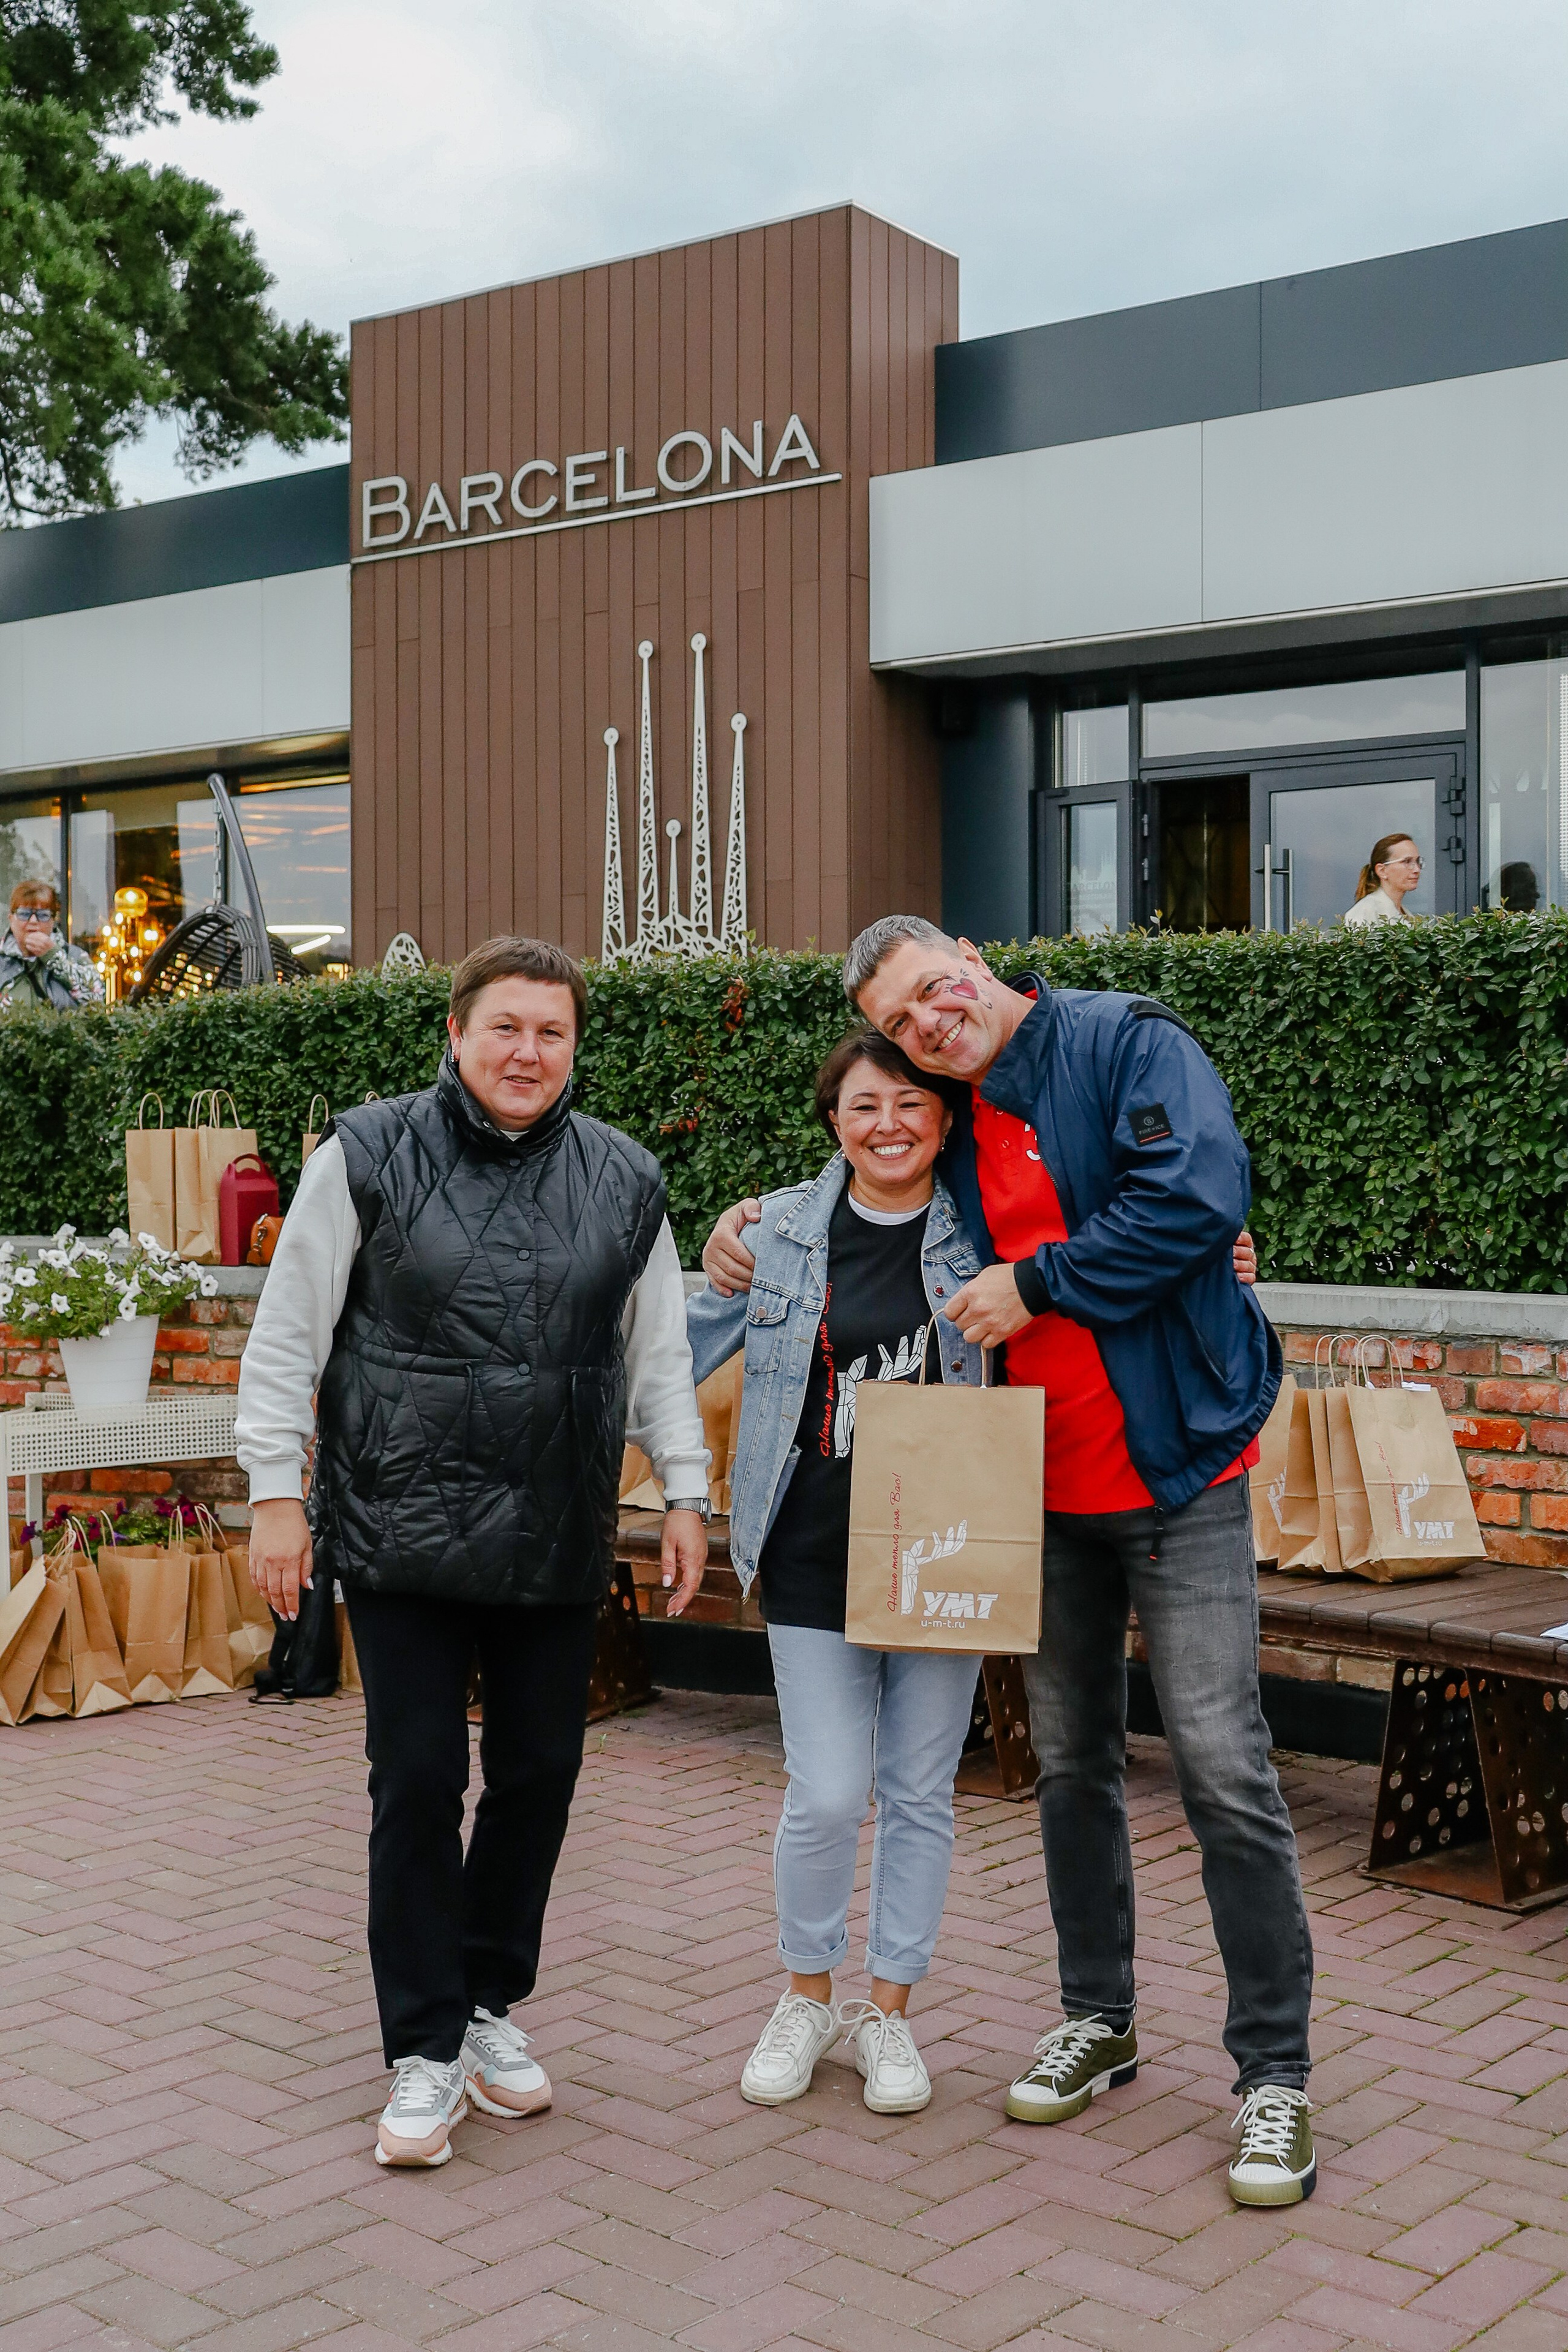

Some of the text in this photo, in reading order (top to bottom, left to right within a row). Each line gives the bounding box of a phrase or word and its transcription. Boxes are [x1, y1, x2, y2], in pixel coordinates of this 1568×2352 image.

[363, 413, 821, 548] BARCELONA
[820, 1322, 834, 1351] для
[818, 1404, 831, 1457] Наше
[889, 1472, 901, 1506] Вас!
[893, 1508, 902, 1531] для
[887, 1572, 897, 1612] Наше
[922, 1591, 999, 1619] УМТ
[921, 1619, 966, 1629] u-m-t.ru
